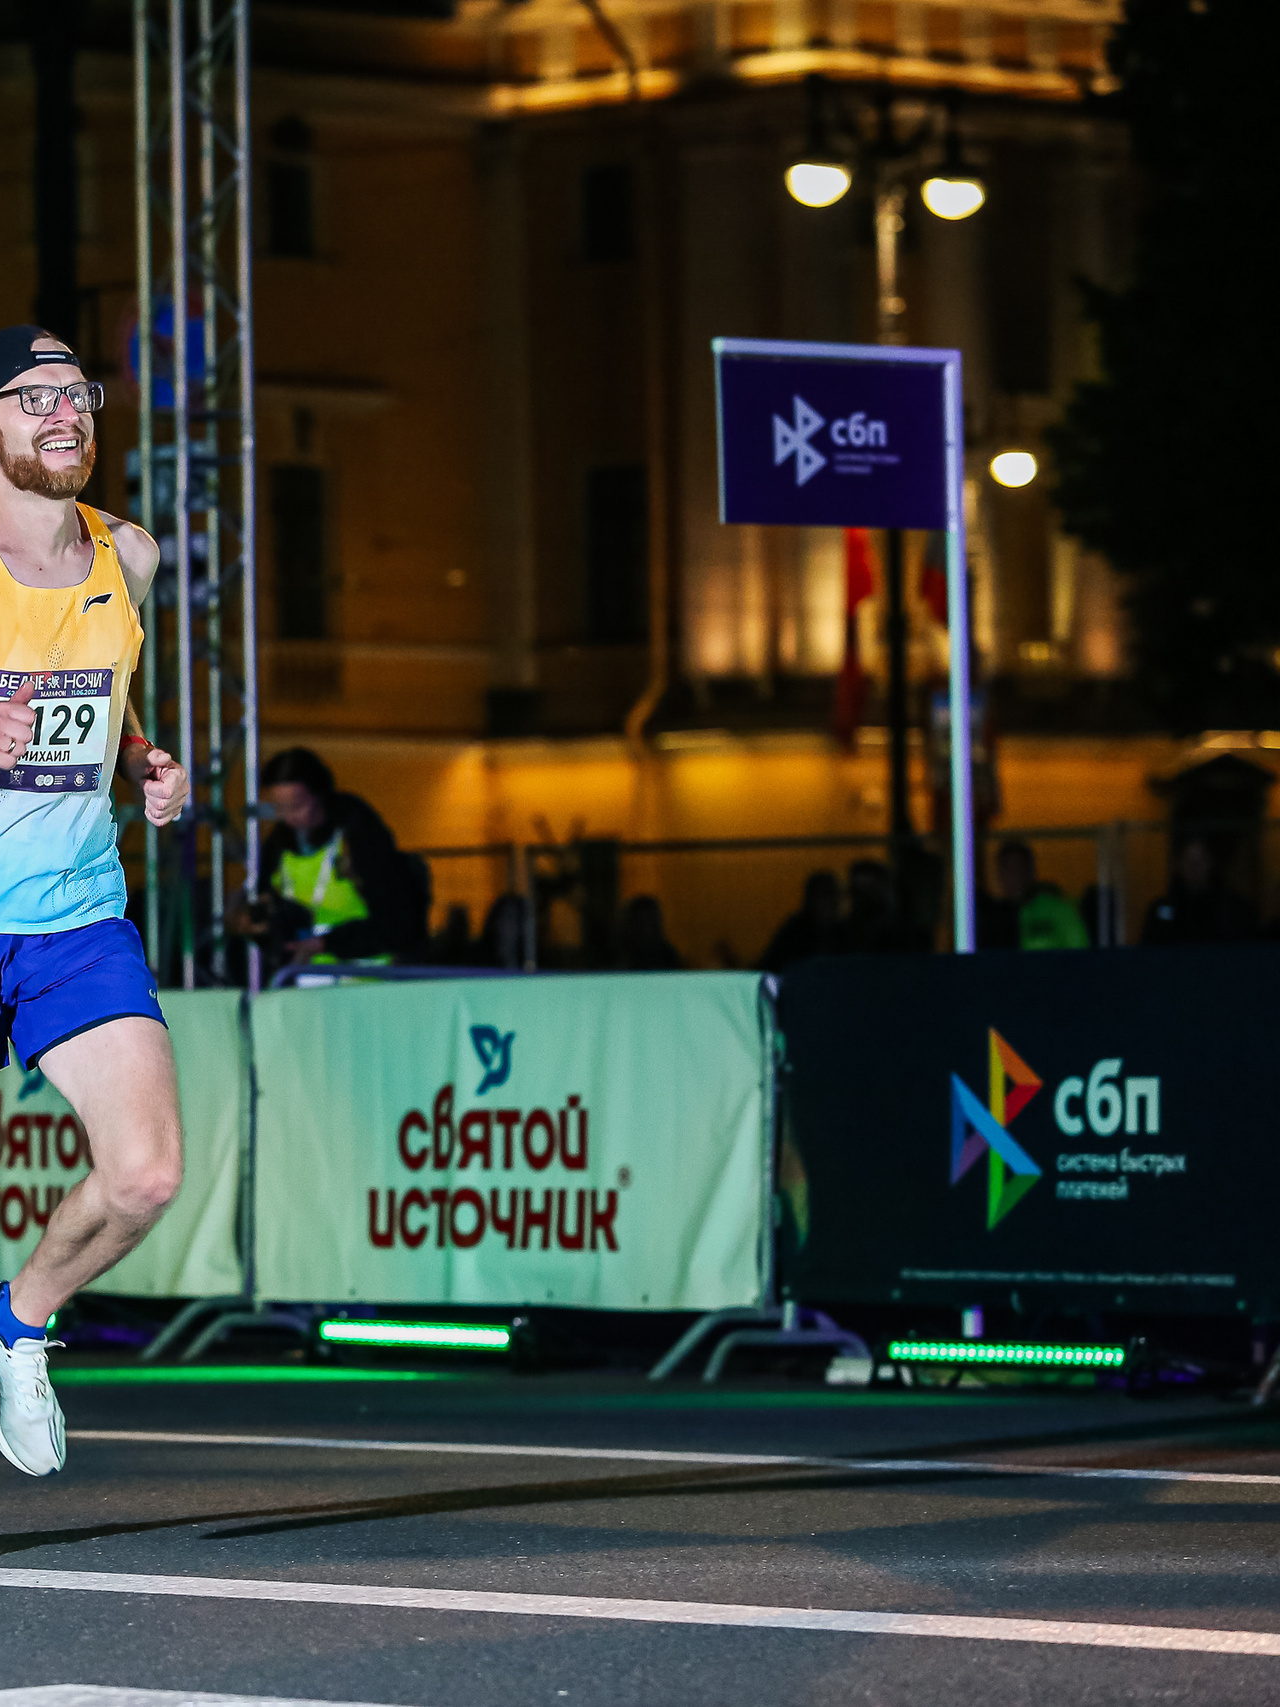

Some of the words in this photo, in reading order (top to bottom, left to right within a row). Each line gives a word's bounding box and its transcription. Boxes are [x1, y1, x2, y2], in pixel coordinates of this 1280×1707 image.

[64, 673, 103, 689] НОЧИ
[33, 704, 95, 745] 129
[1054, 1058, 1160, 1137] сбп
